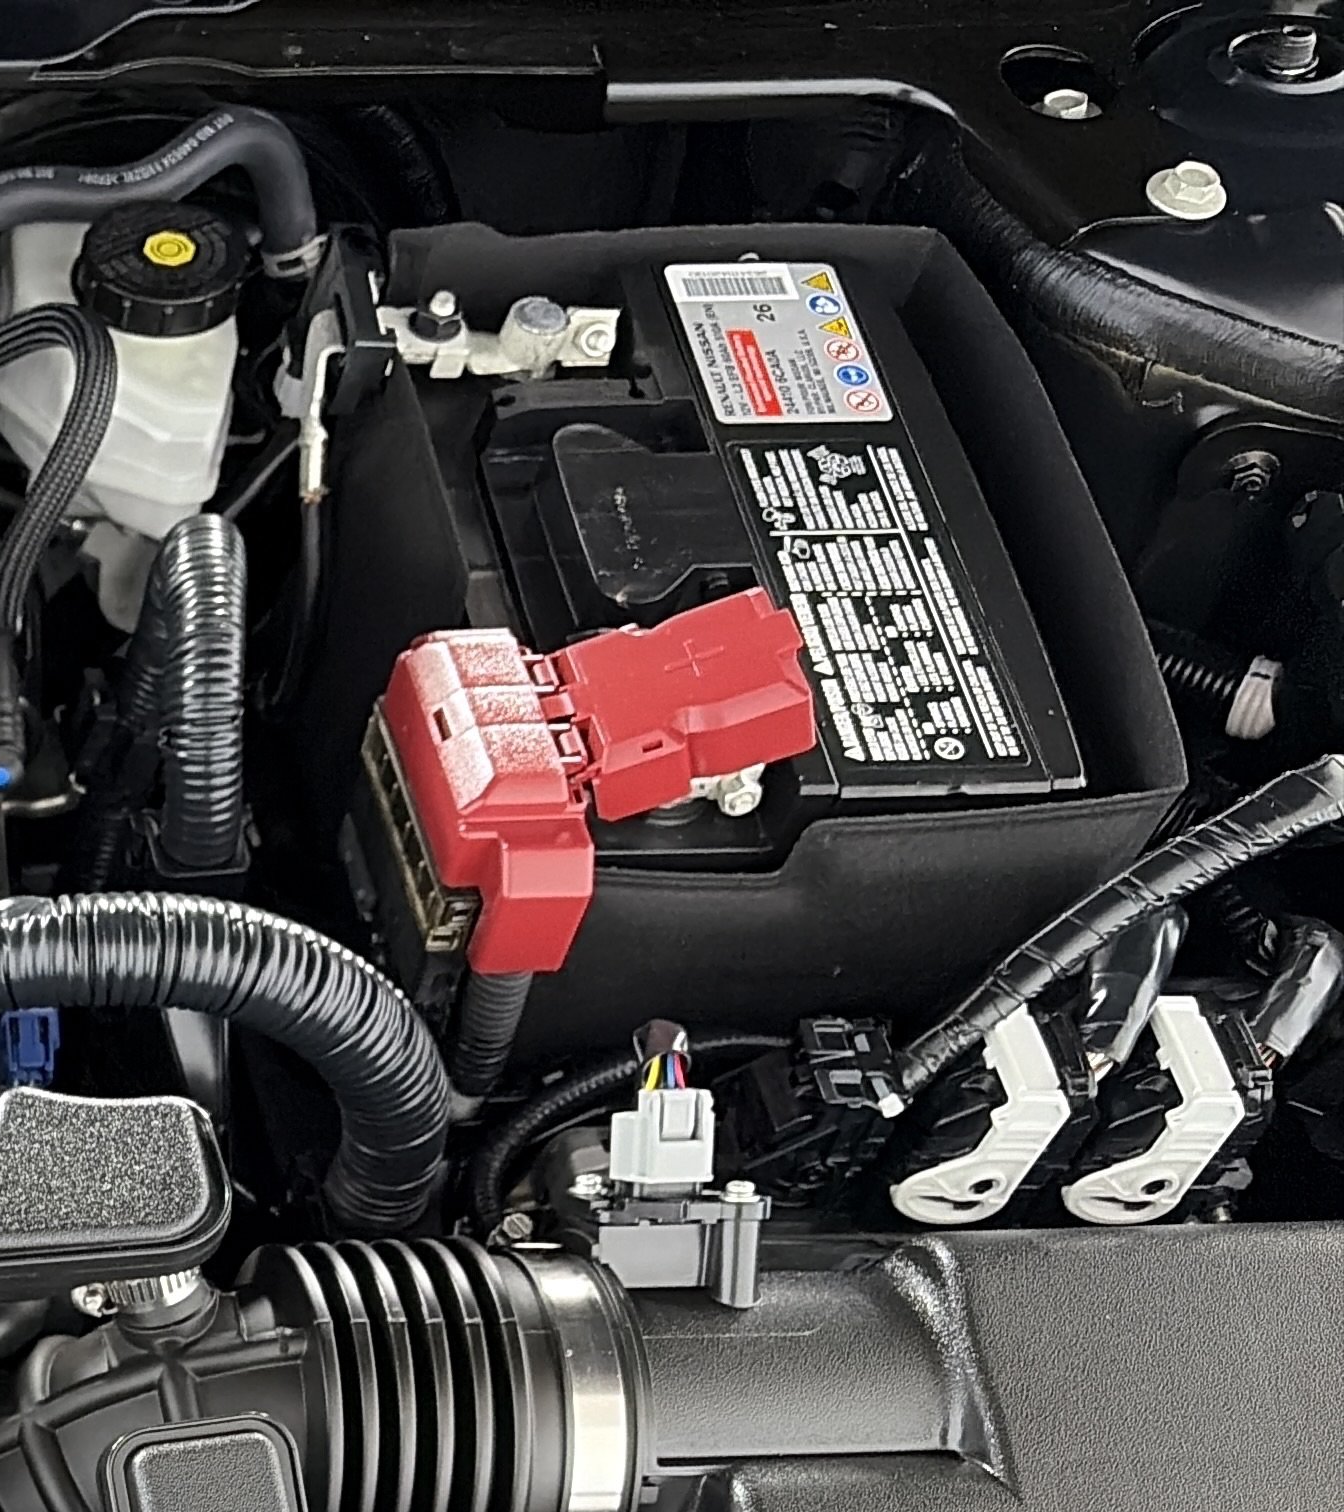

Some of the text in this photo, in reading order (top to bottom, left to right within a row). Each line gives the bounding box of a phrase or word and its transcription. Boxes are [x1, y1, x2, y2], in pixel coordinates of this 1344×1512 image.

[752, 303, 775, 321] 26
[692, 321, 735, 416] RENAULT NISSAN
